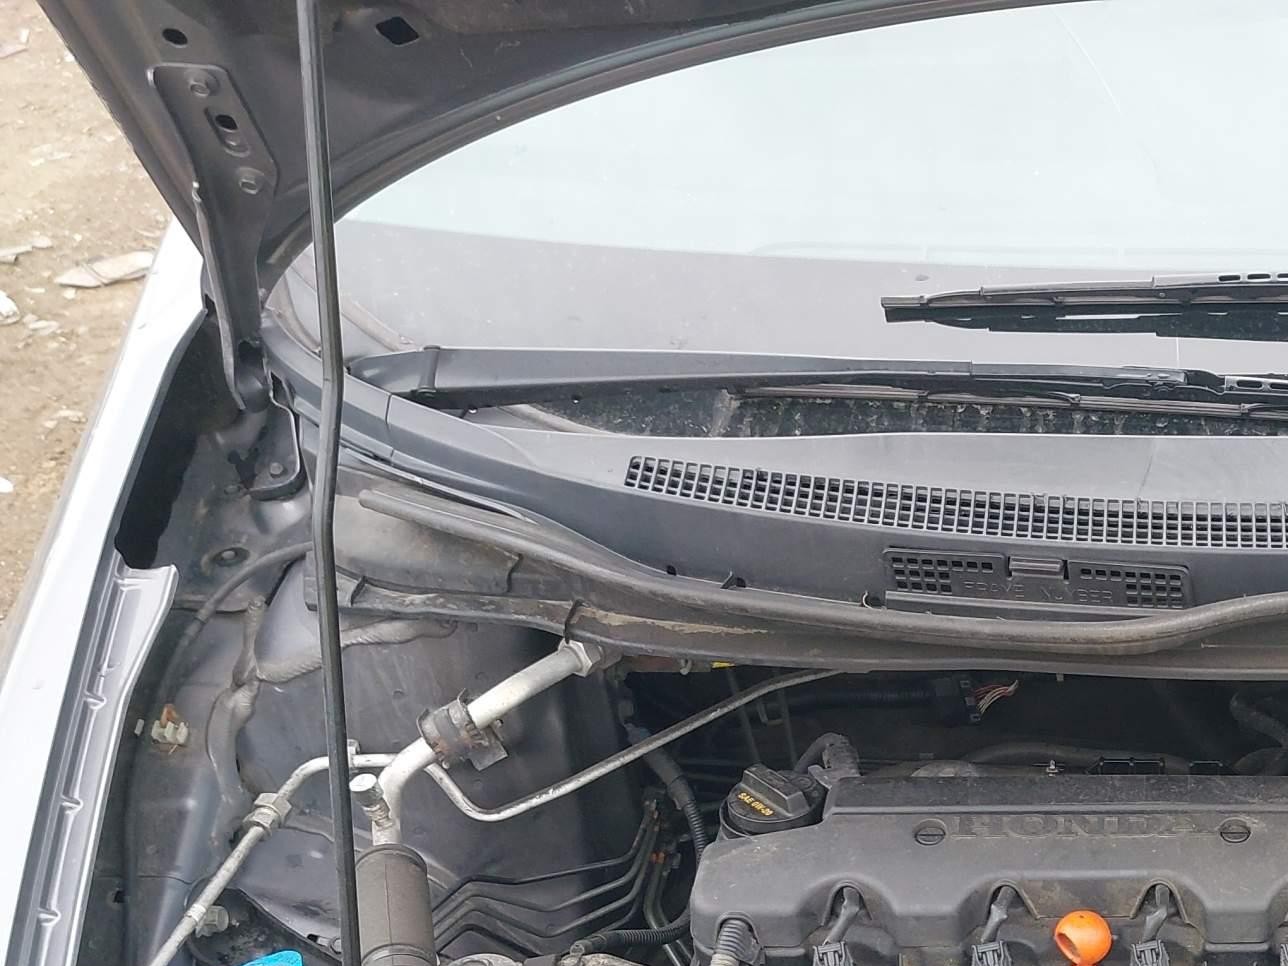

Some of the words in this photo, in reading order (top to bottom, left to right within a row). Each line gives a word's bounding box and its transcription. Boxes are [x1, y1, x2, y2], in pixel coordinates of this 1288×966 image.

[963, 581, 1025, 598] FRAME
[1040, 587, 1113, 603] NUMBER
[738, 792, 755, 804] SAE
[951, 814, 1218, 839] HONDA
